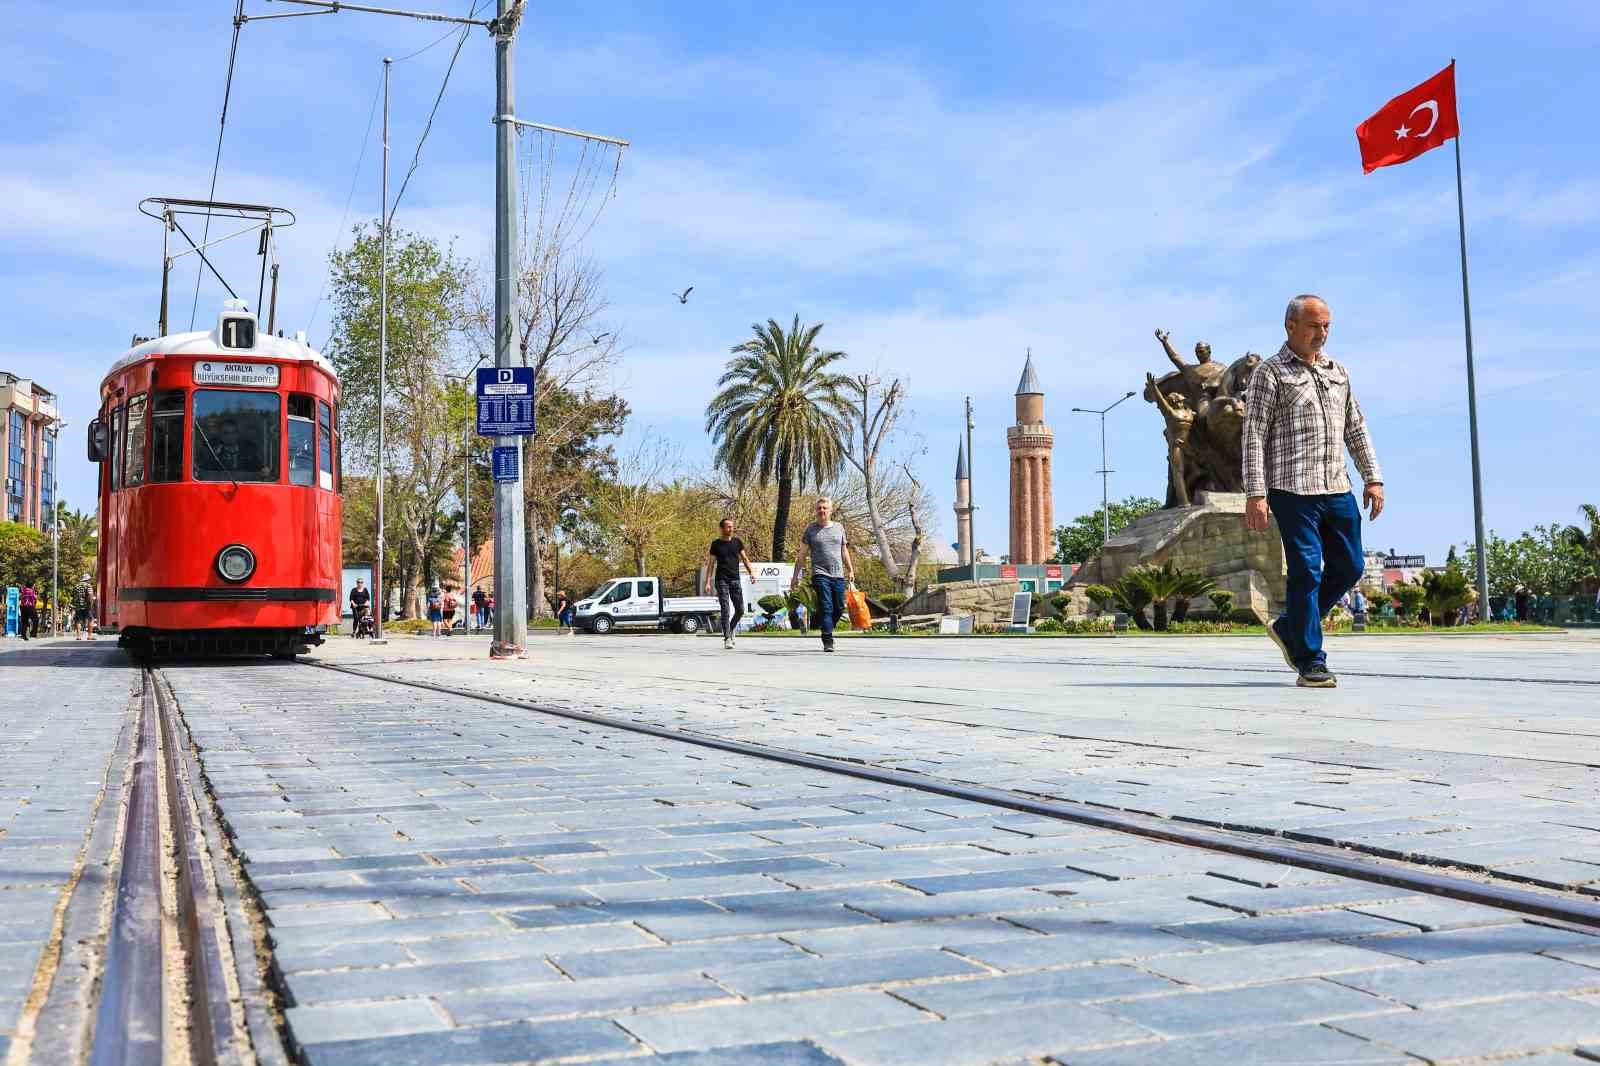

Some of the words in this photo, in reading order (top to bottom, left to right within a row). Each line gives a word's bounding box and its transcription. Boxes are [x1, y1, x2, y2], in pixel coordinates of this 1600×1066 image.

[228, 321, 237, 347] 1
[224, 364, 253, 373] ANTALYA
[500, 371, 511, 381] D
[761, 567, 780, 576] ARO
